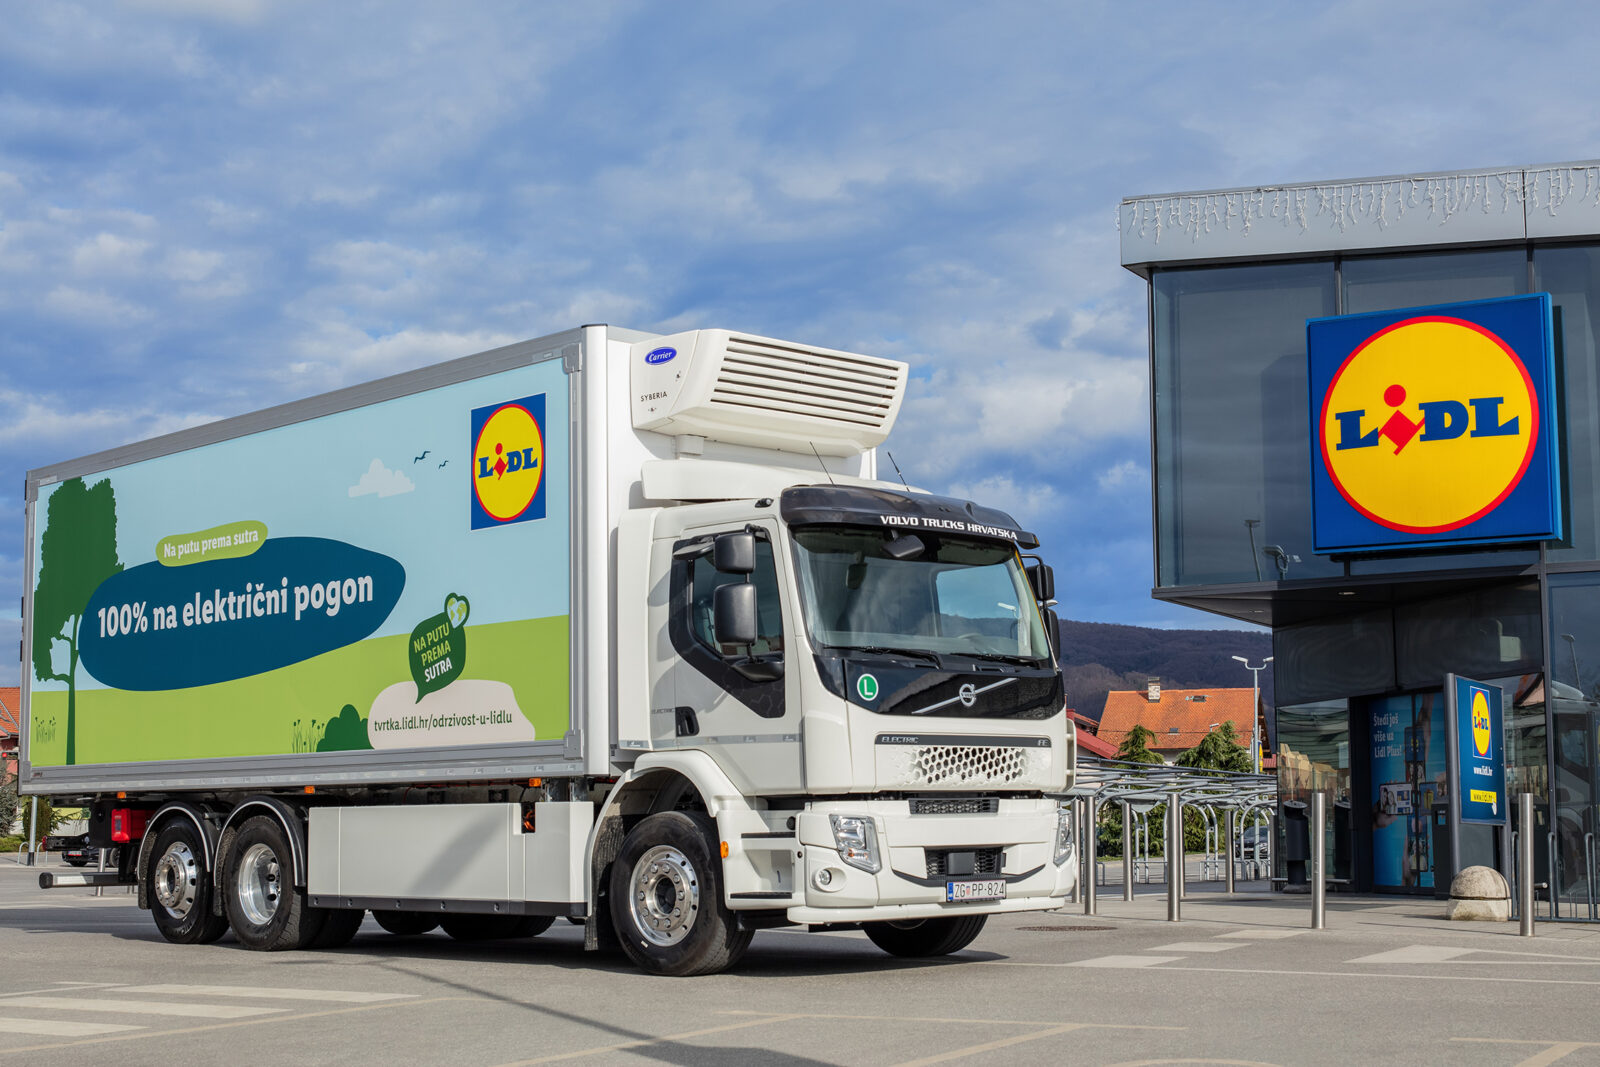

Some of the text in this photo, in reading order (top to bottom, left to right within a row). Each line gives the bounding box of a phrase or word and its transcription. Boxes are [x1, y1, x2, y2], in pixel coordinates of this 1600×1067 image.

[648, 351, 673, 362] Carrier
[640, 391, 668, 402] SYBERIA
[1335, 384, 1520, 456] LIDL
[478, 442, 538, 480] LIDL
[880, 515, 1018, 540] VOLVO TRUCKS HRVATSKA
[163, 530, 258, 559] Na putu prema sutra
[98, 575, 373, 638] 100% na električni pogon
[413, 622, 450, 653] NA PUTU
[421, 640, 452, 667] PREMA
[424, 657, 453, 682] SUTRA
[863, 679, 874, 695] L
[374, 710, 513, 732] tvrtka.lidl.hr/odrzivost-u-lidlu
[1473, 710, 1489, 731] LIDL
[881, 736, 1048, 747] ELECTRIC FE
[1374, 746, 1386, 758] Lidl
[955, 882, 1004, 898] ZG PP-824
